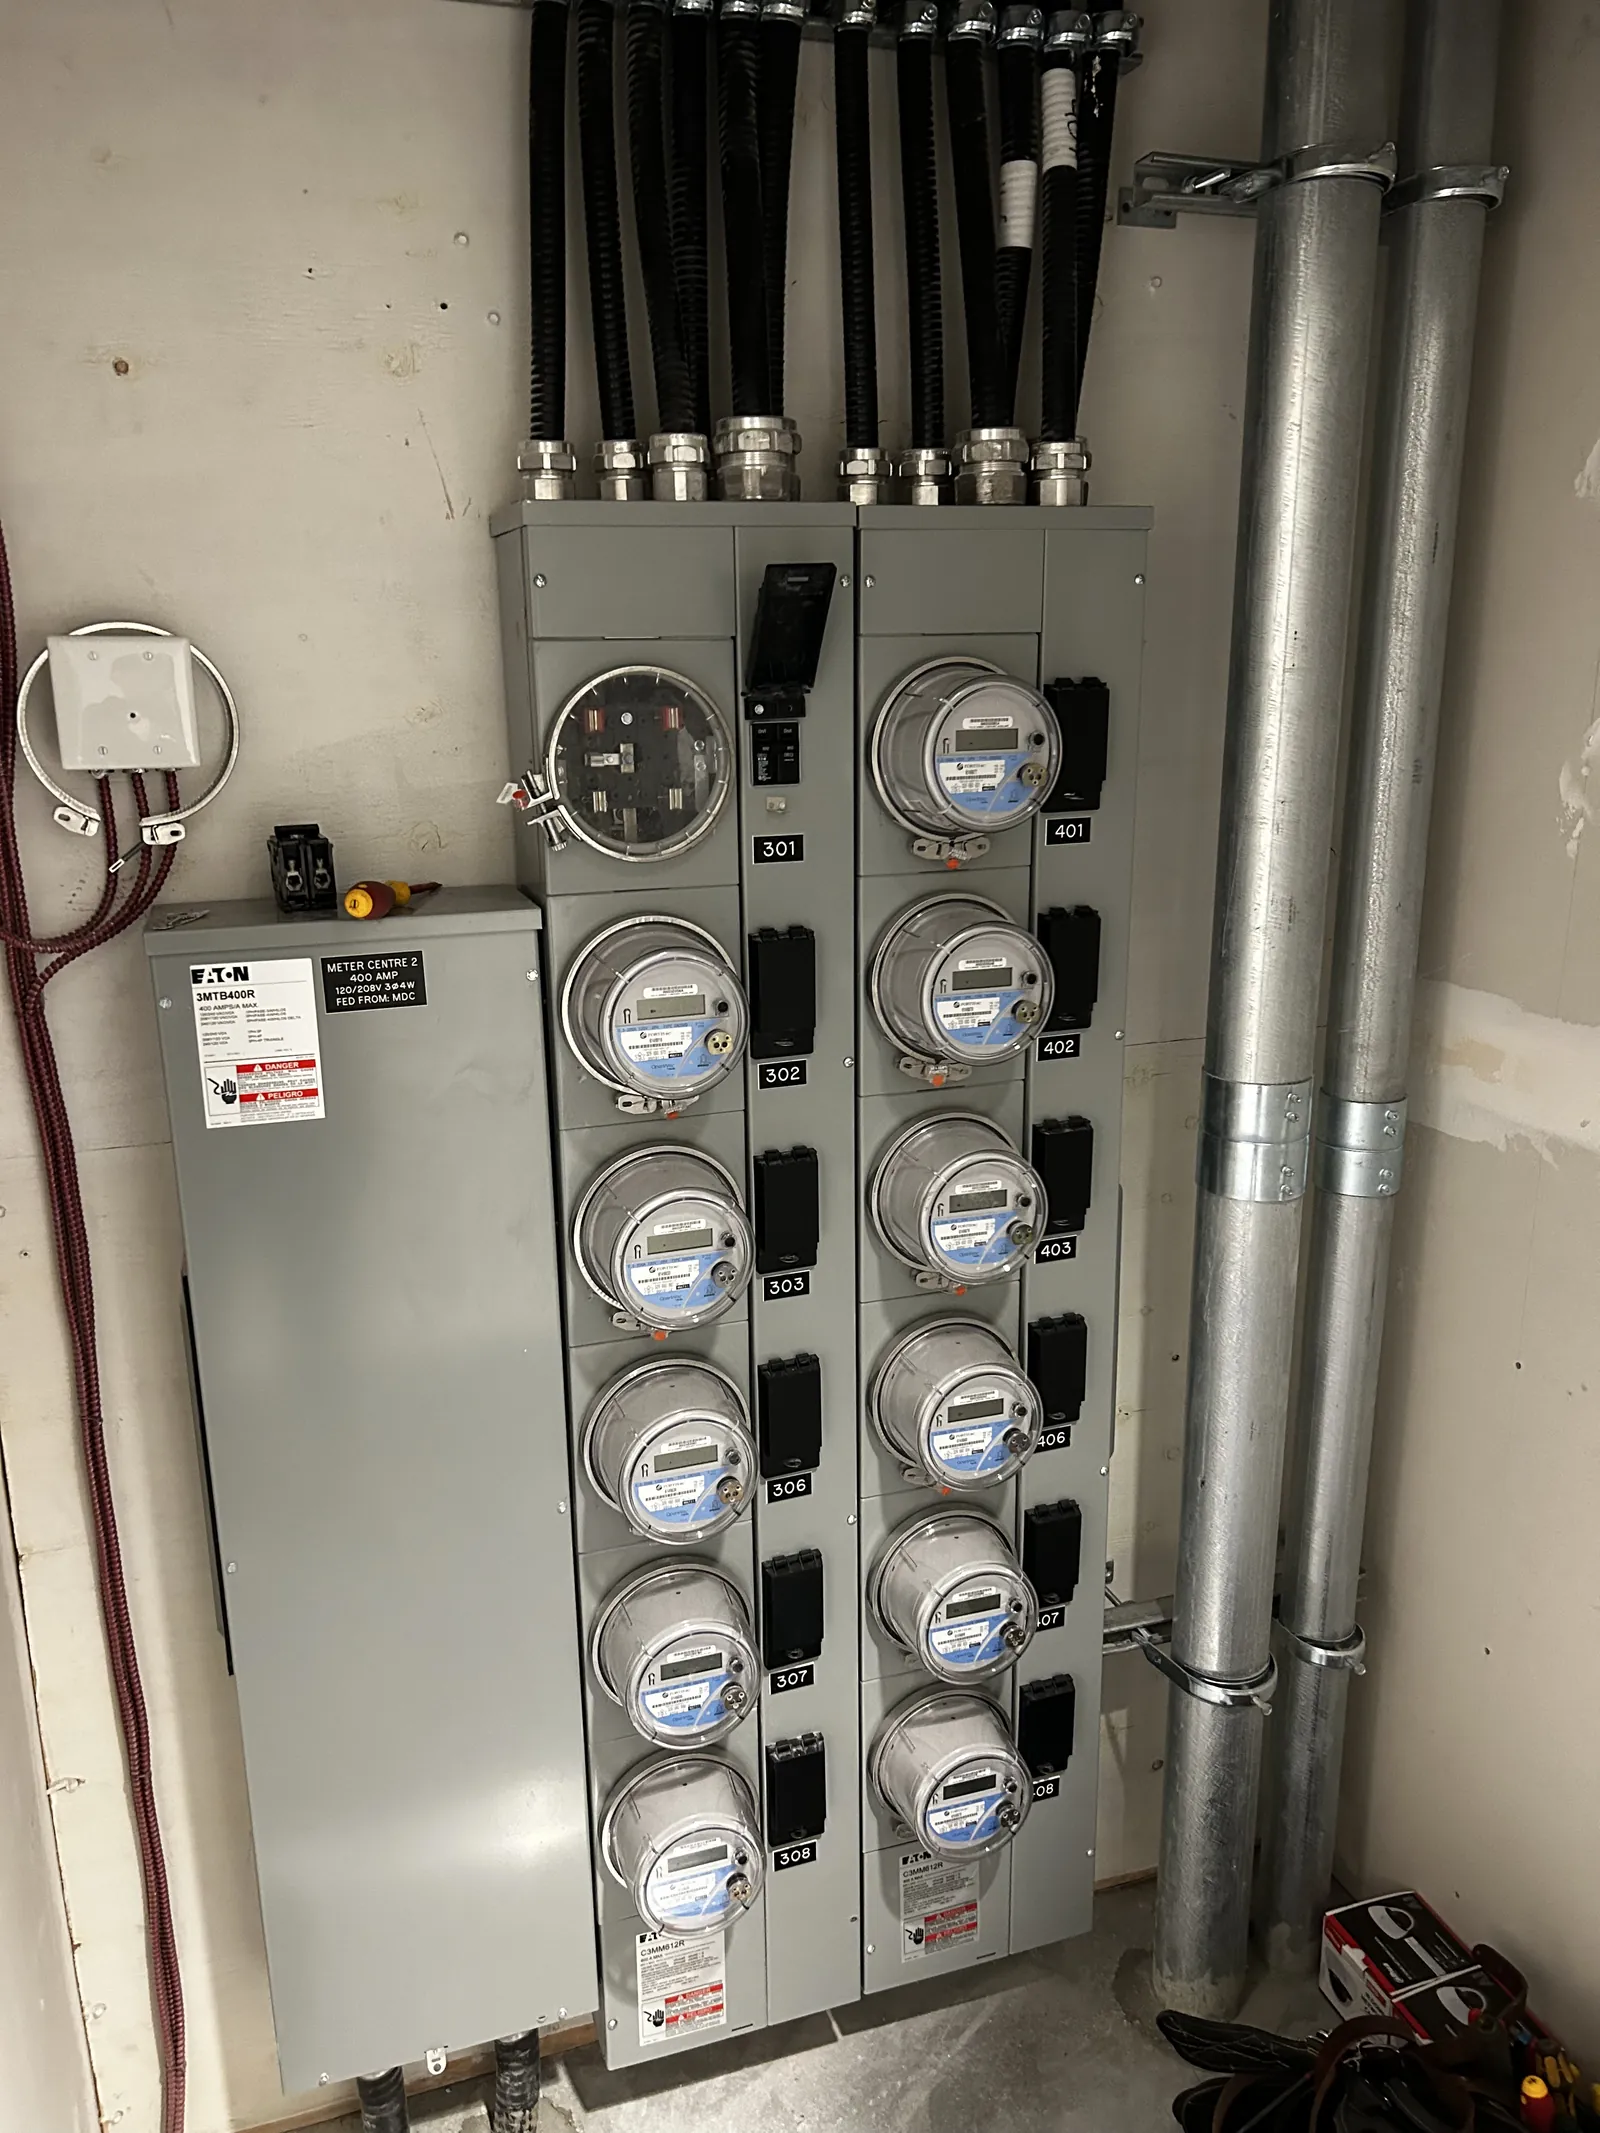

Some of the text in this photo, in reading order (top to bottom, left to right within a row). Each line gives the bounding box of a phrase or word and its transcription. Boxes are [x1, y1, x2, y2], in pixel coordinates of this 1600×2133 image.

[1055, 824, 1083, 838] 401
[763, 841, 795, 857] 301
[327, 957, 418, 973] METER CENTRE 2
[191, 966, 249, 984] EATON
[350, 971, 399, 982] 400 AMP
[196, 989, 256, 1002] 3MTB400R
[335, 984, 382, 995] 120/208V
[336, 992, 416, 1006] FED FROM: MDC
[213, 1003, 240, 1011] AMPS/A
[1044, 1039, 1074, 1055] 402
[265, 1062, 299, 1070] DANGER
[765, 1066, 800, 1083] 302
[268, 1091, 303, 1099] PELIGRO
[1040, 1242, 1072, 1257] 403
[769, 1278, 804, 1295] 303
[1037, 1431, 1065, 1447] 406
[773, 1479, 806, 1497] 306
[776, 1670, 808, 1688] 307
[1033, 1783, 1054, 1797] 08
[780, 1848, 811, 1866] 308
